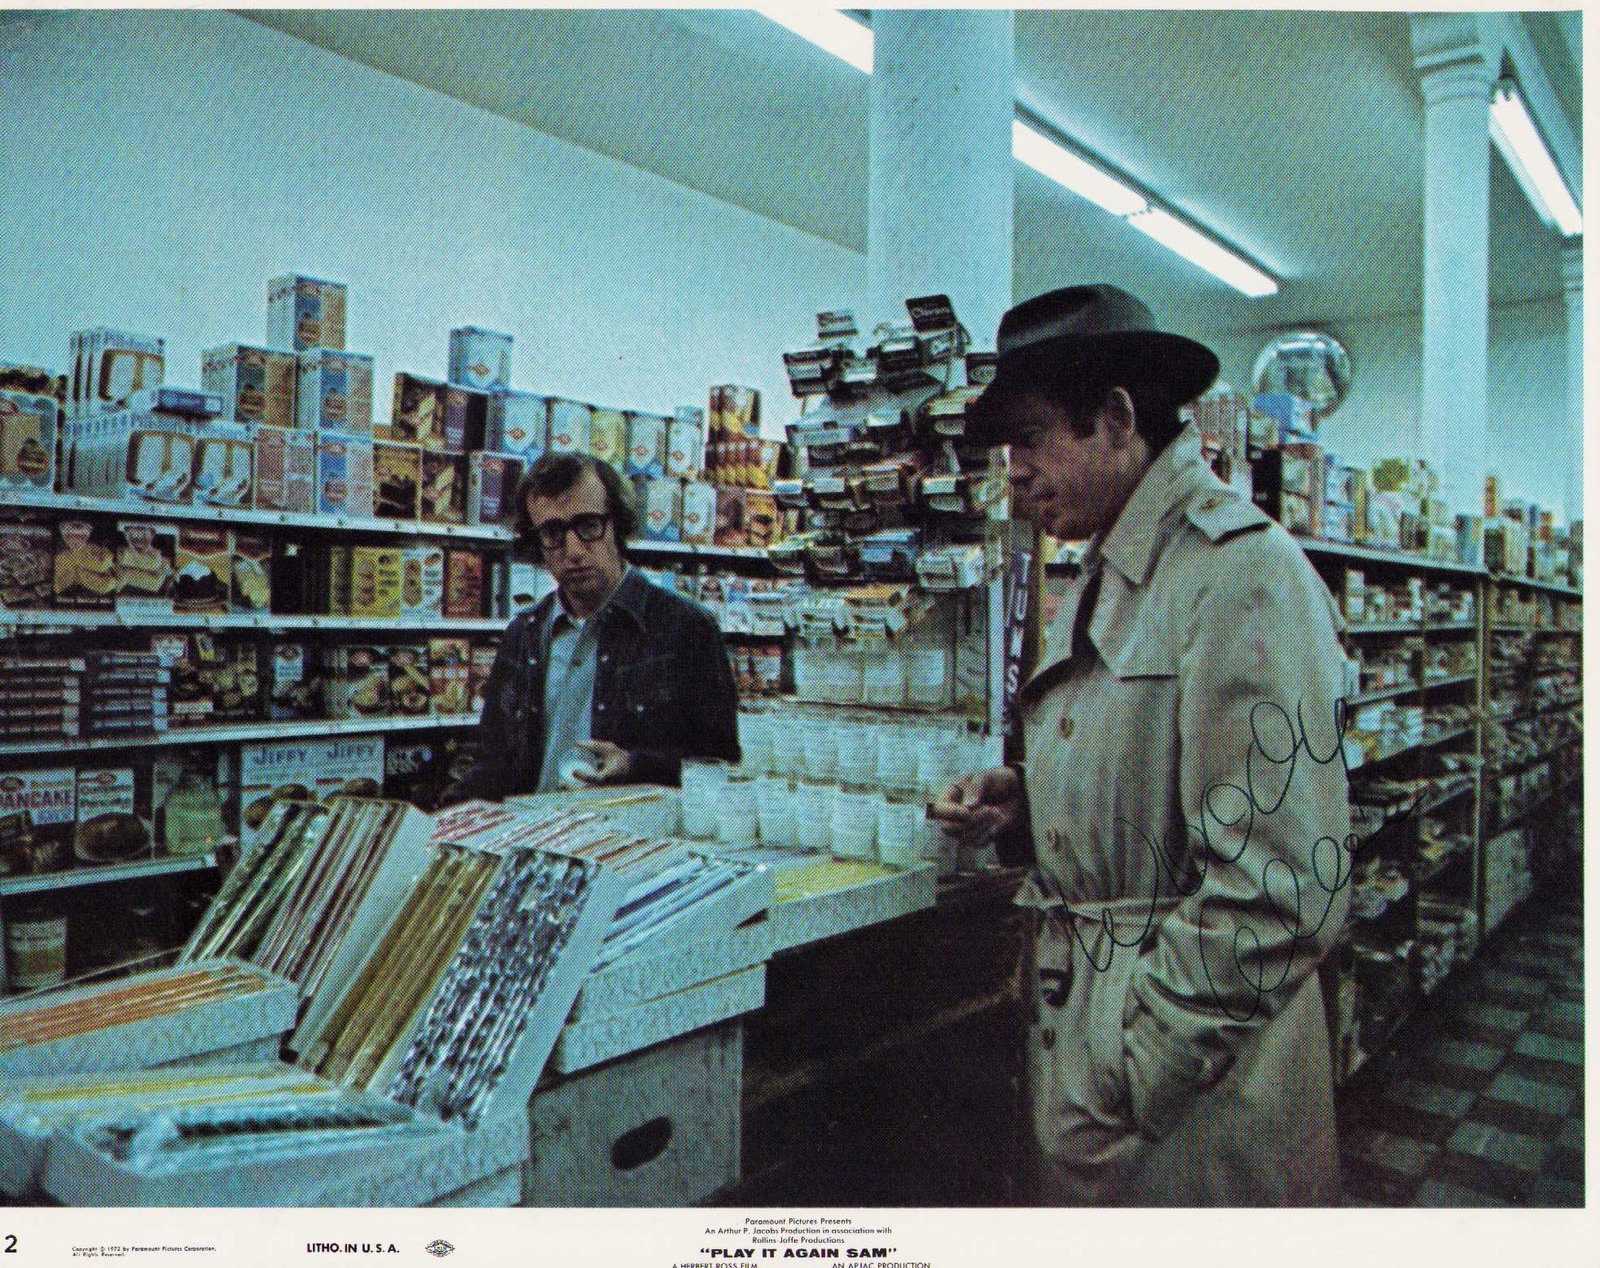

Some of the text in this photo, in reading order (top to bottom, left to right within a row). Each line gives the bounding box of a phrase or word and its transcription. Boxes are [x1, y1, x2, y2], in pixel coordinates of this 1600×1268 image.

[745, 1217, 852, 1226] Paramount Pictures Presents
[704, 1226, 893, 1235] An Arthur P. Jacobs Production in association with
[4, 1233, 18, 1254] 2
[751, 1236, 845, 1244] Rollins Joffe Productions
[306, 1242, 343, 1254] LITHO.
[344, 1242, 358, 1254] IN
[761, 1248, 778, 1258] IT
[782, 1247, 840, 1258] AGAIN
